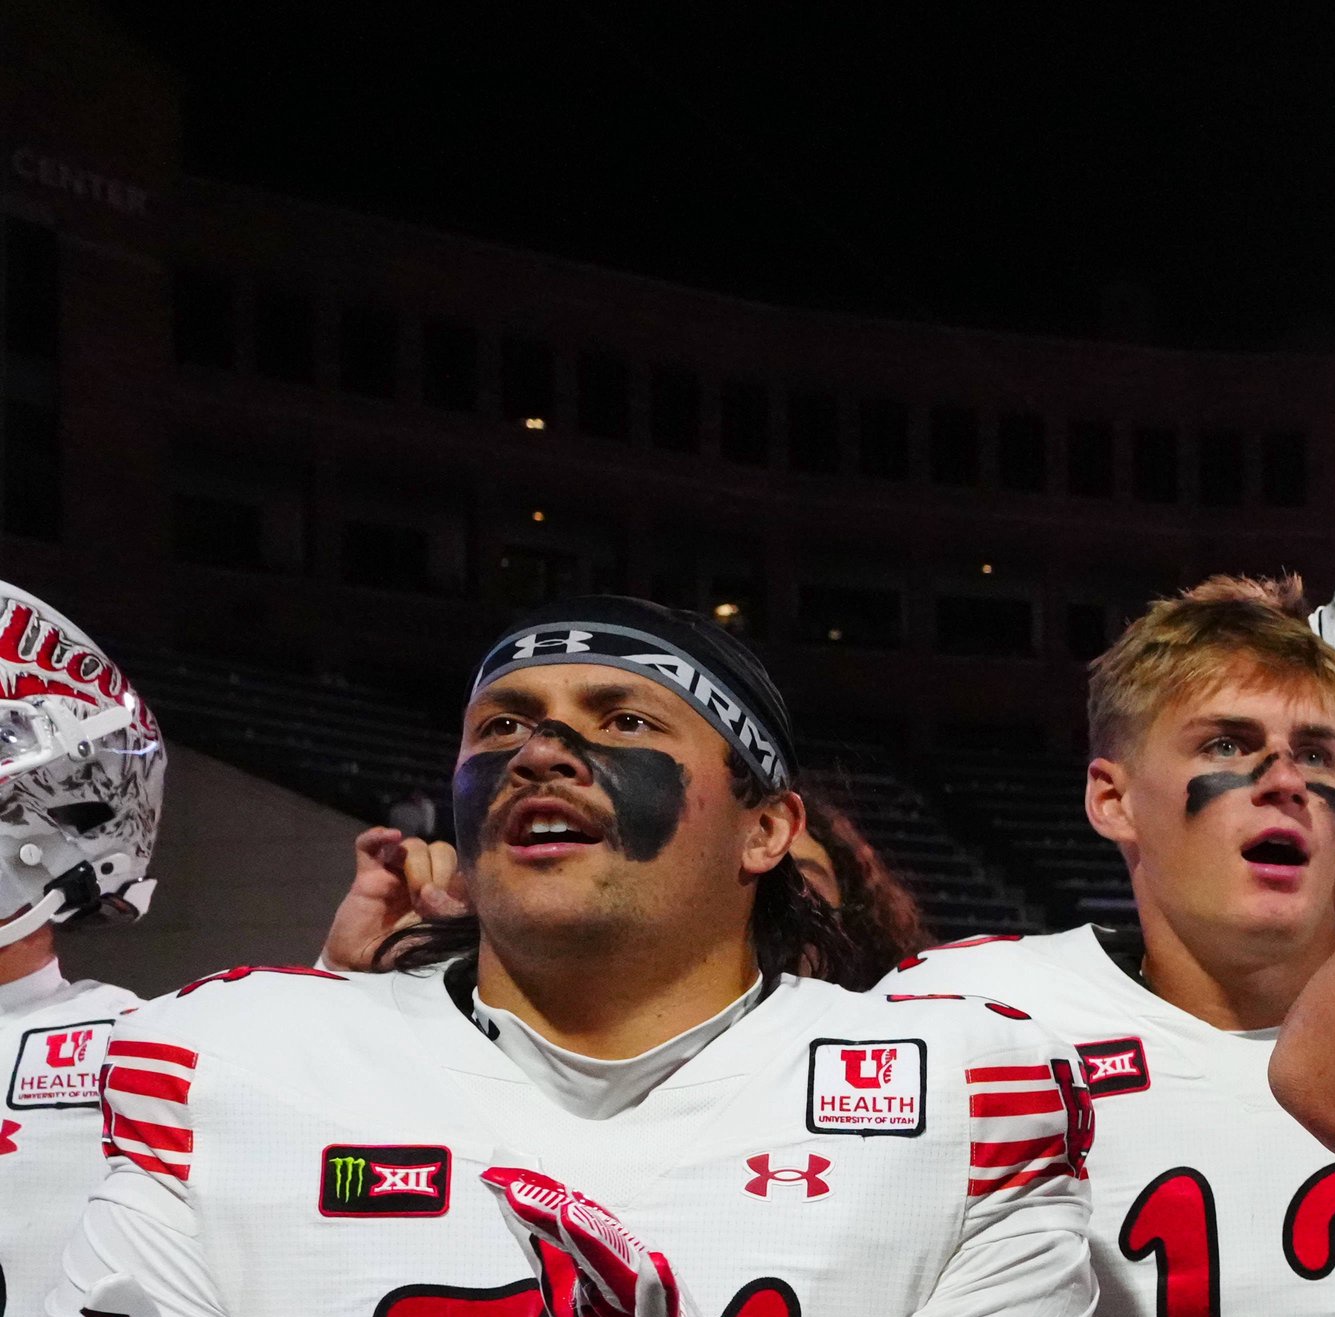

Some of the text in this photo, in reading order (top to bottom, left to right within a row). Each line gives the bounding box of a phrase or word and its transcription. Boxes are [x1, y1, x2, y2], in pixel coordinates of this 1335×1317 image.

[1088, 1053, 1137, 1080] XII
[18, 1092, 65, 1100] UNIVERSITY
[820, 1095, 914, 1113] HEALTH
[818, 1115, 914, 1125] UNIVERSITY OF UTAH
[373, 1166, 437, 1194] XII
